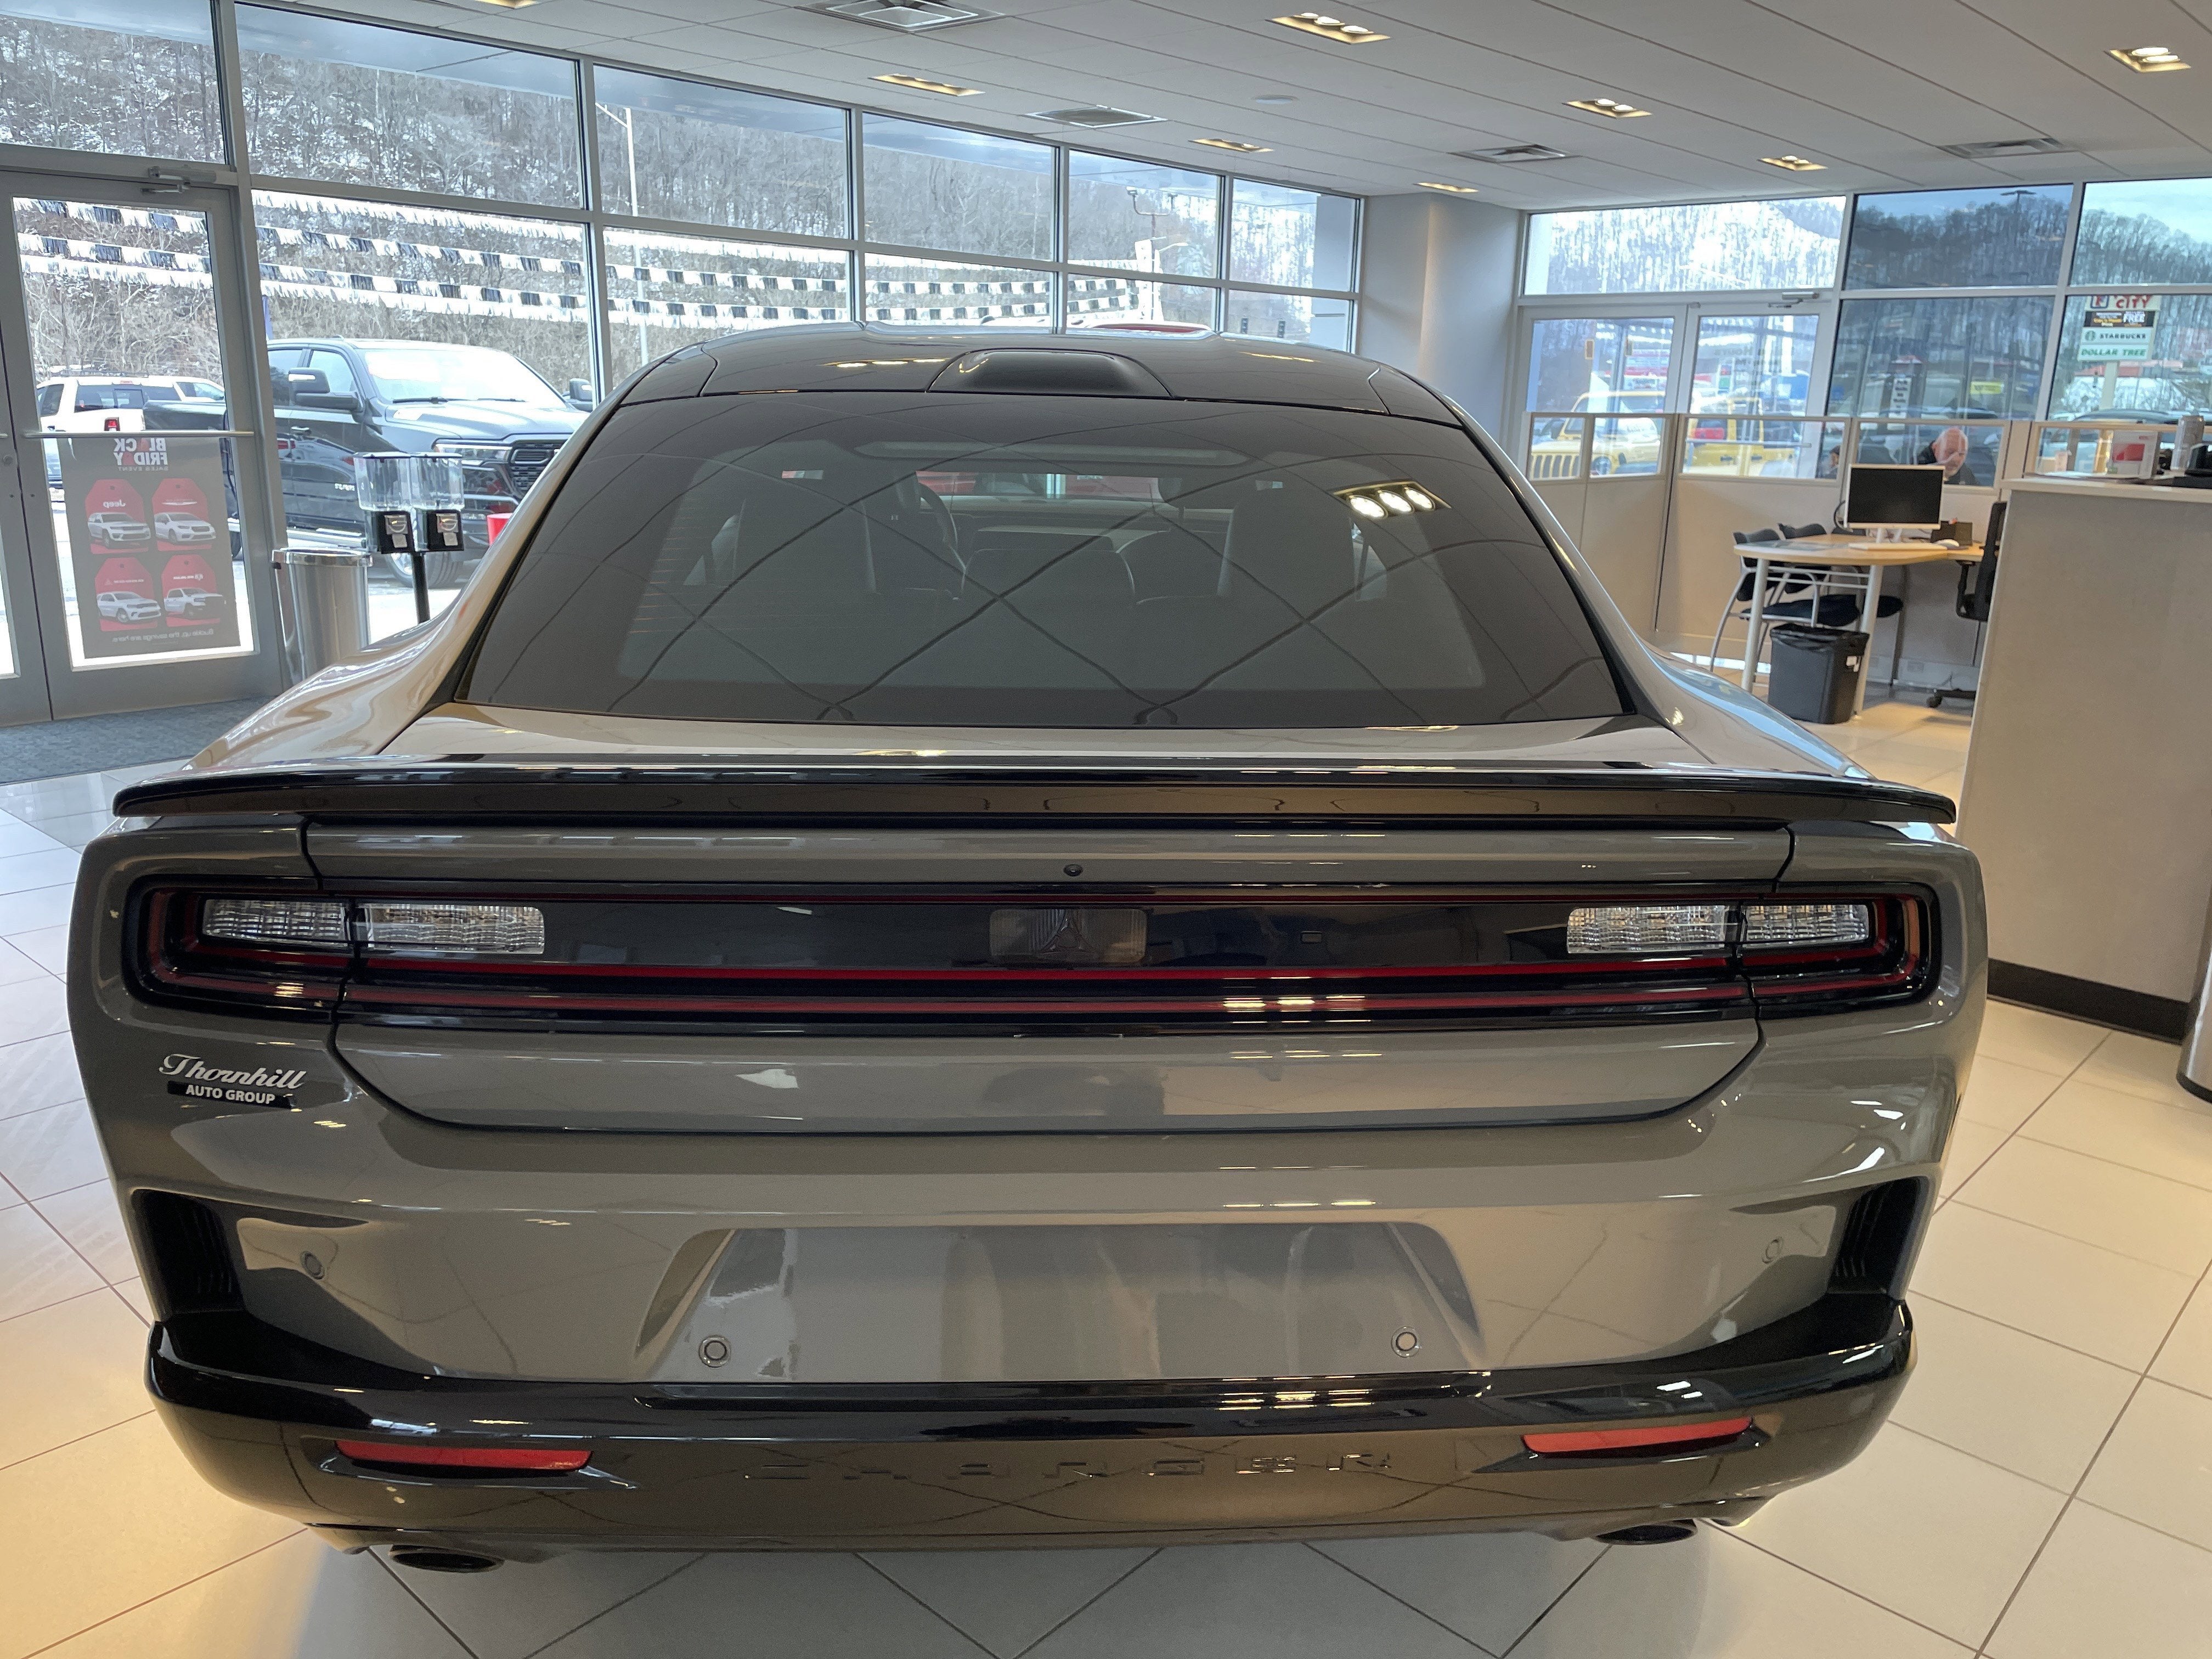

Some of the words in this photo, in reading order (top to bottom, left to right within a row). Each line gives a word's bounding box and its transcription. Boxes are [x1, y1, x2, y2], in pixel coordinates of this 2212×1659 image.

[159, 1053, 307, 1090] Thornhill
[185, 1084, 223, 1099] AUTO
[225, 1089, 275, 1104] GROUP
